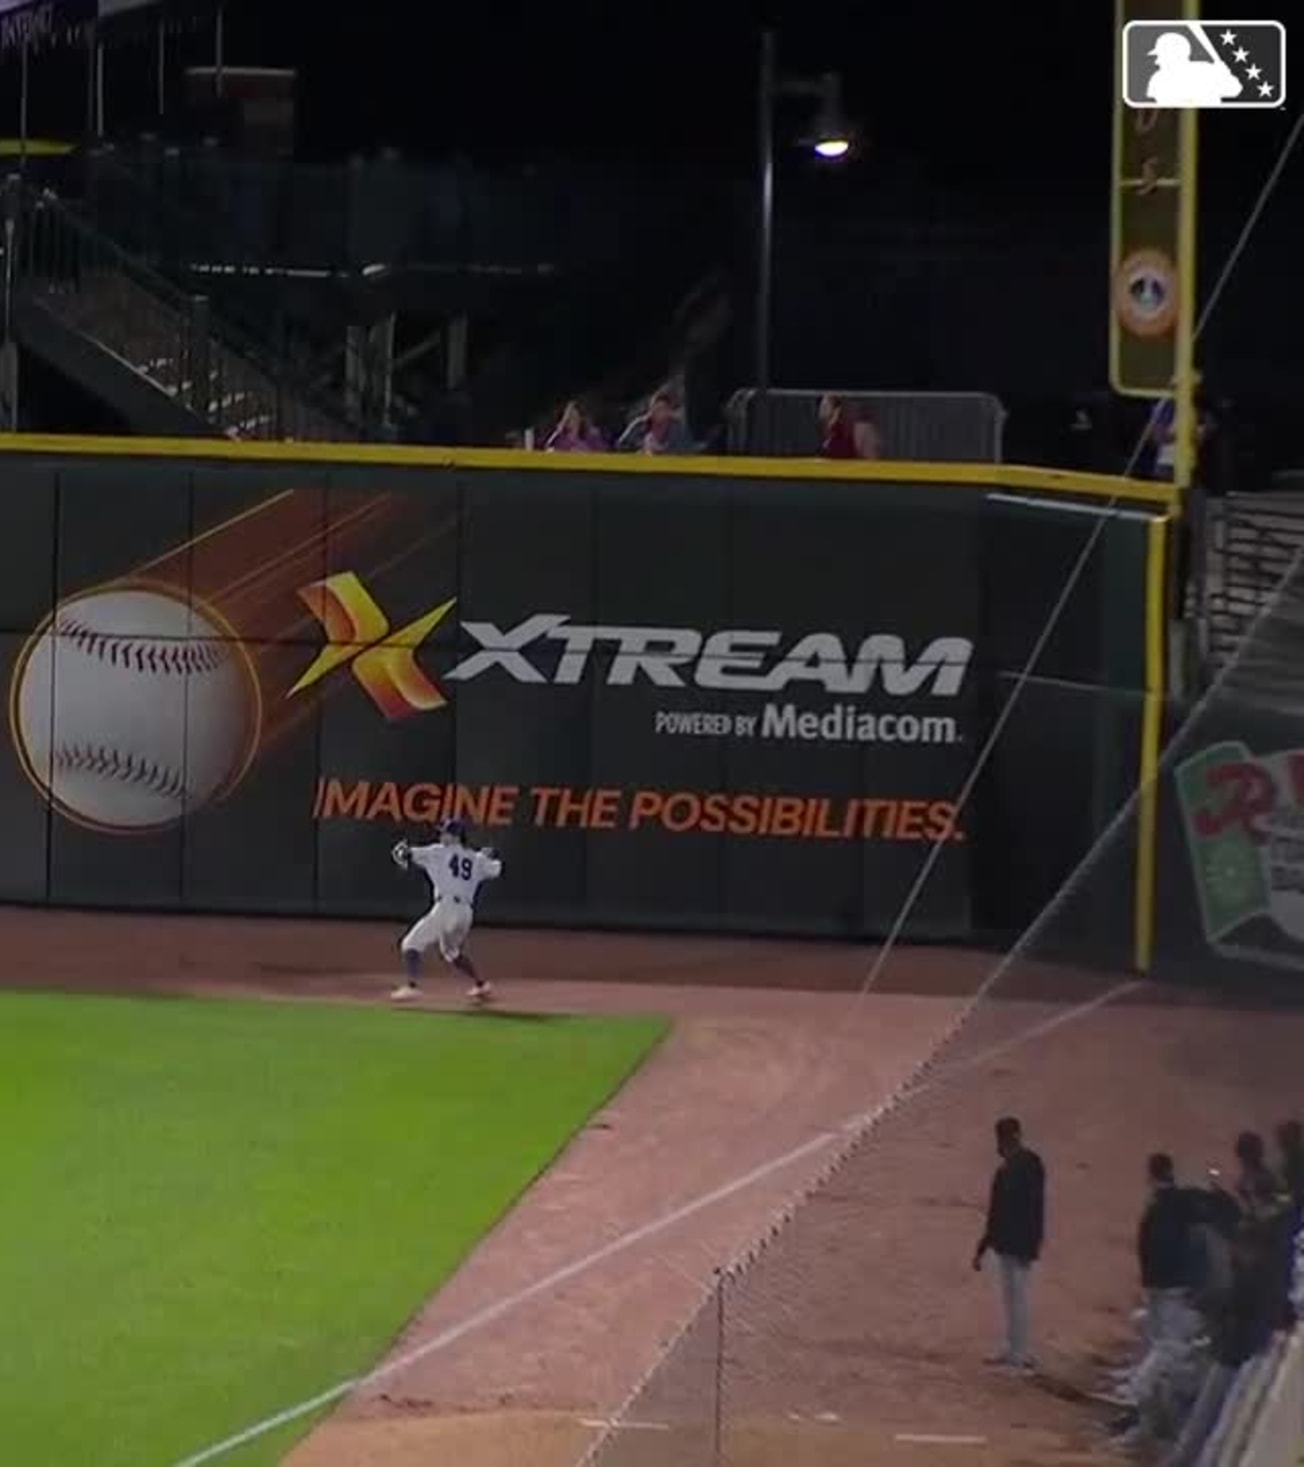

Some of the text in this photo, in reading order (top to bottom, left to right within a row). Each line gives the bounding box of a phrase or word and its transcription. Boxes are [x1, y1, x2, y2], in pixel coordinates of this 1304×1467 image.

[444, 612, 975, 695] XTREAM
[654, 710, 733, 735] POWERED
[734, 715, 757, 737] BY
[312, 776, 967, 841] IMAGINE THE POSSIBILITIES.
[448, 852, 473, 880] 49
